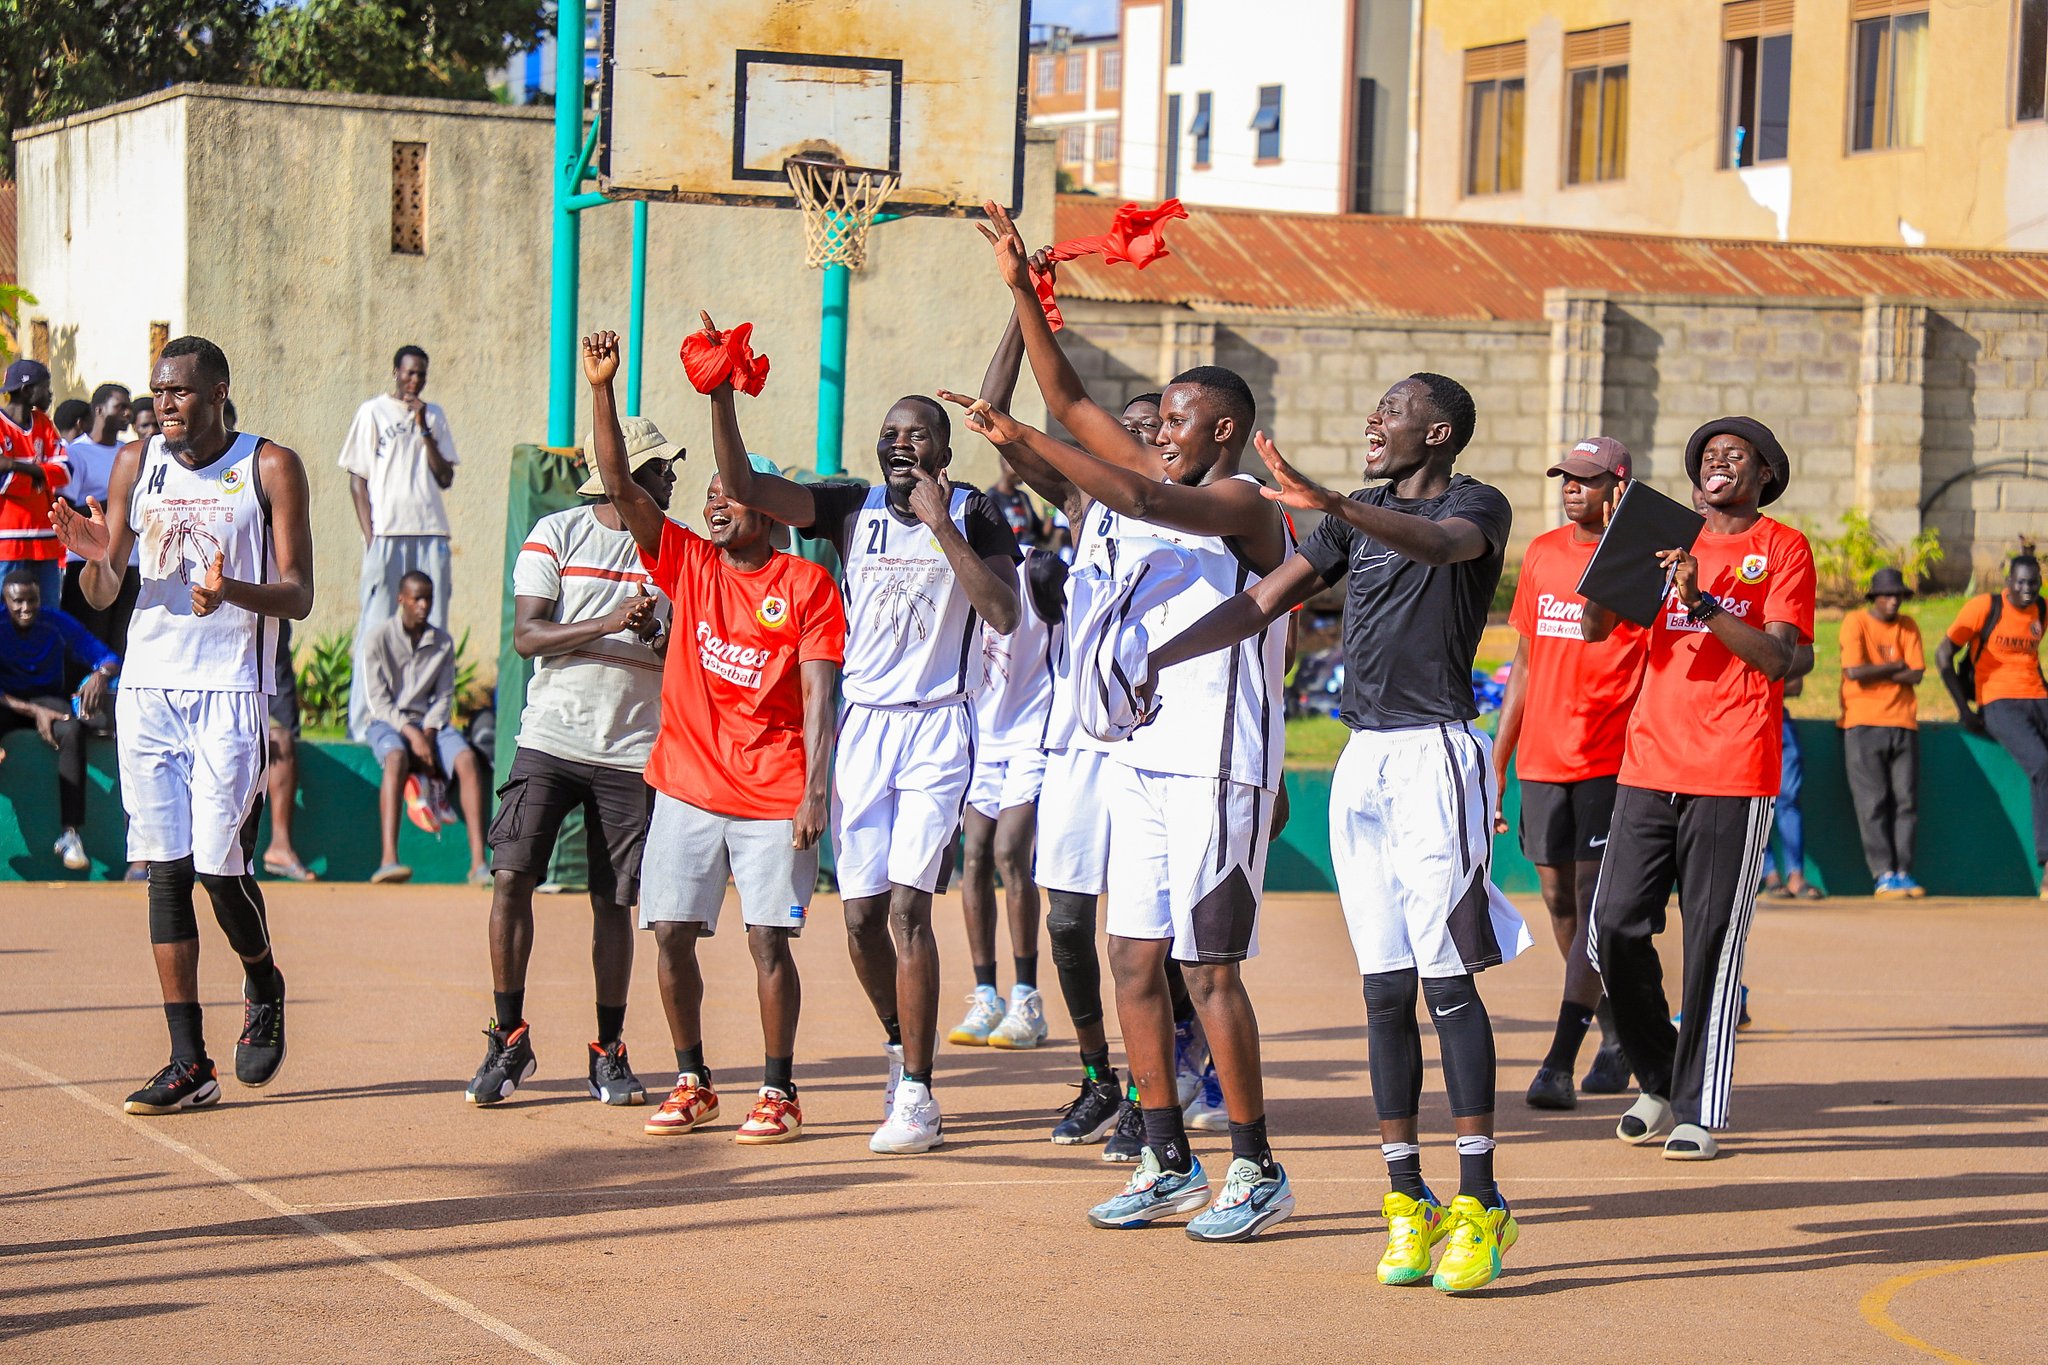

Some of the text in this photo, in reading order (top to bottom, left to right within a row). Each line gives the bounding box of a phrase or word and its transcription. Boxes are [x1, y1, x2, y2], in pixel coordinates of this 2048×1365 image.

[147, 463, 168, 495] 14
[144, 512, 235, 524] FLAMES
[866, 519, 889, 554] 21
[861, 572, 952, 585] FLAMES
[1538, 594, 1584, 621] Flam
